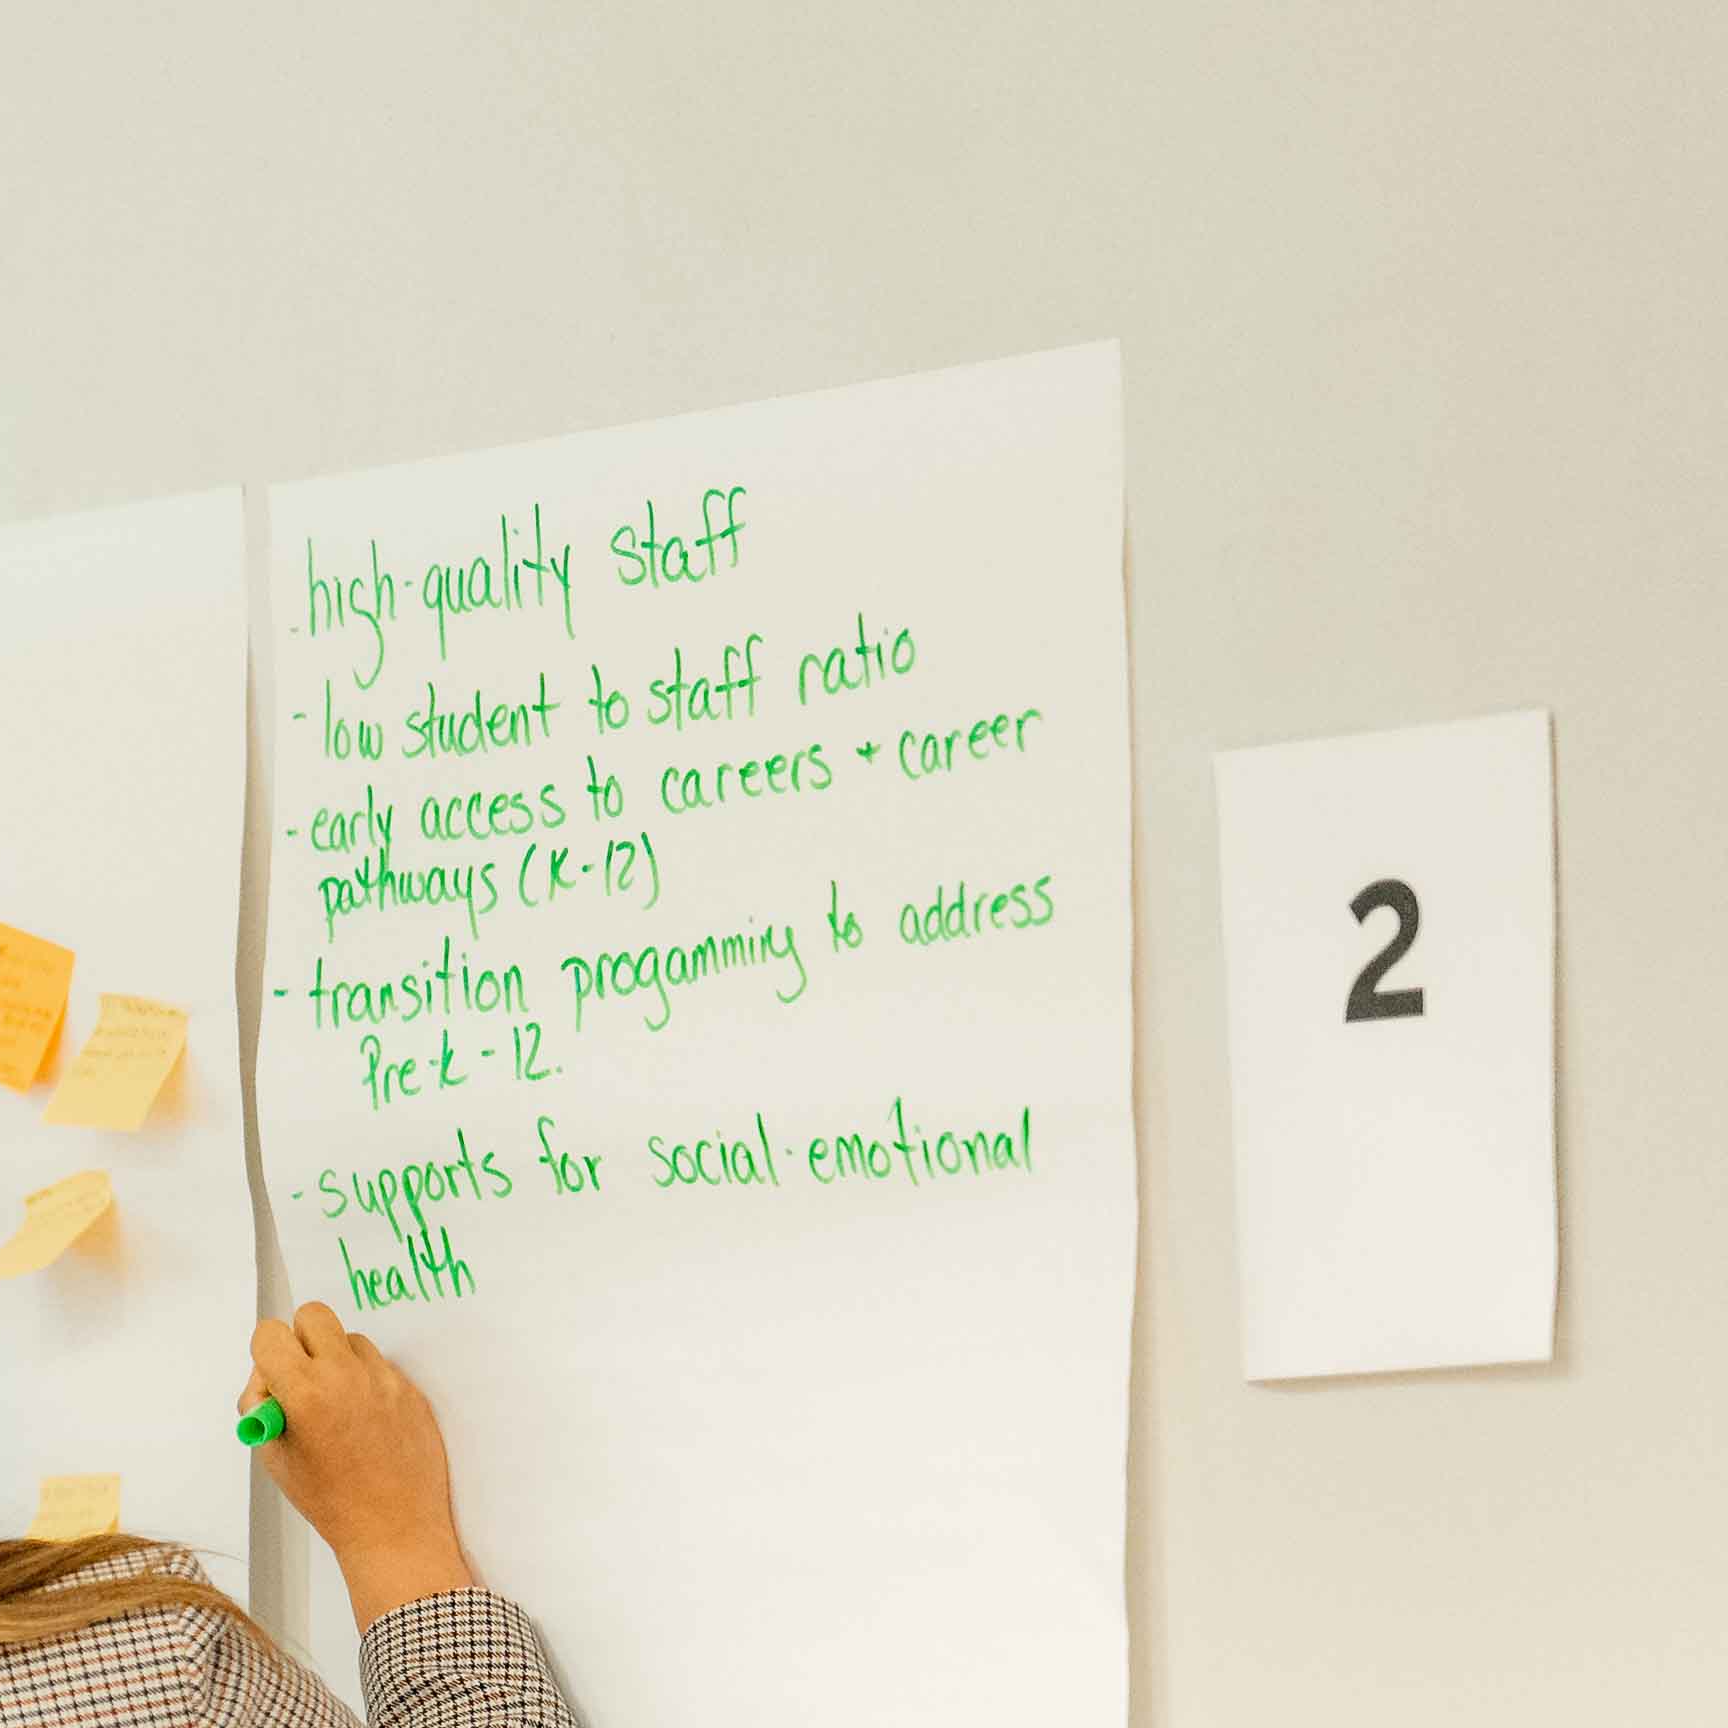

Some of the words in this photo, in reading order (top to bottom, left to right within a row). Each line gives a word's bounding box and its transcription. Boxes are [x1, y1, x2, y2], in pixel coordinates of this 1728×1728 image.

[401, 672, 561, 761] student
[586, 664, 630, 737] to
[647, 632, 764, 731] staff
[798, 612, 918, 706] ratio
[419, 784, 567, 843] access
[586, 754, 625, 820] to
[660, 741, 834, 816] careers
[897, 705, 1043, 782] career
[318, 845, 499, 944] pathways
[827, 879, 865, 951] to
[897, 872, 1056, 946] address
[1344, 878, 1426, 1024] 2
[536, 1114, 604, 1196] for
[337, 1225, 477, 1313] health
